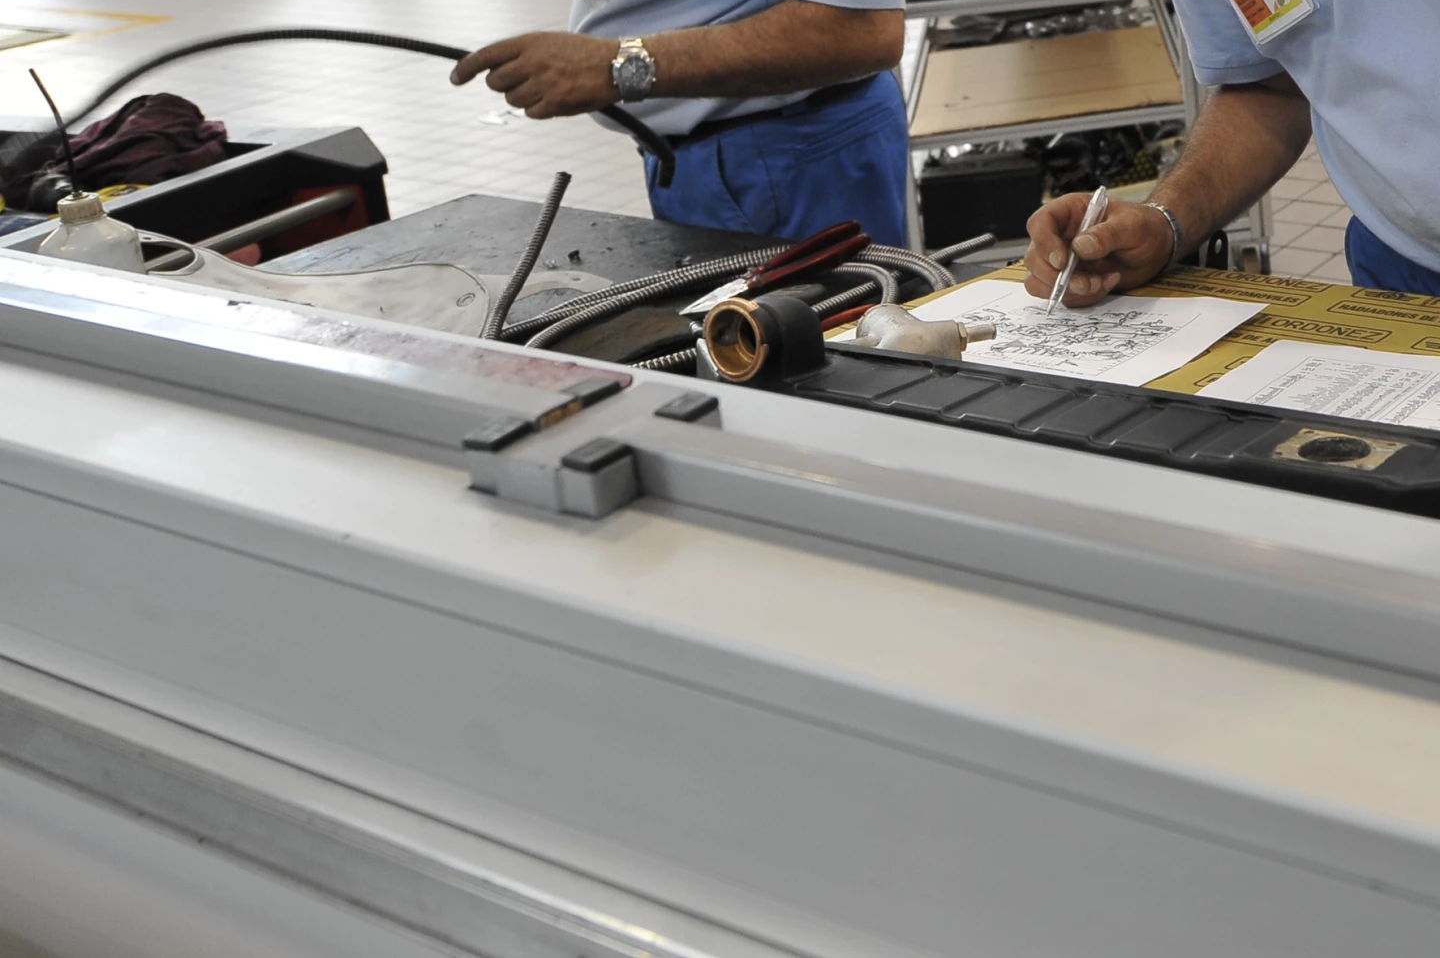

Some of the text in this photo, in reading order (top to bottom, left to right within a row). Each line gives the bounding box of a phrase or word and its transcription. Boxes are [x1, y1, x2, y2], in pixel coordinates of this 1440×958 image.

[1215, 287, 1300, 304] AUTOMOVILES
[1338, 303, 1419, 321] RADIADORES
[1419, 315, 1439, 323] DE
[1271, 318, 1384, 341] ORDONEZ
